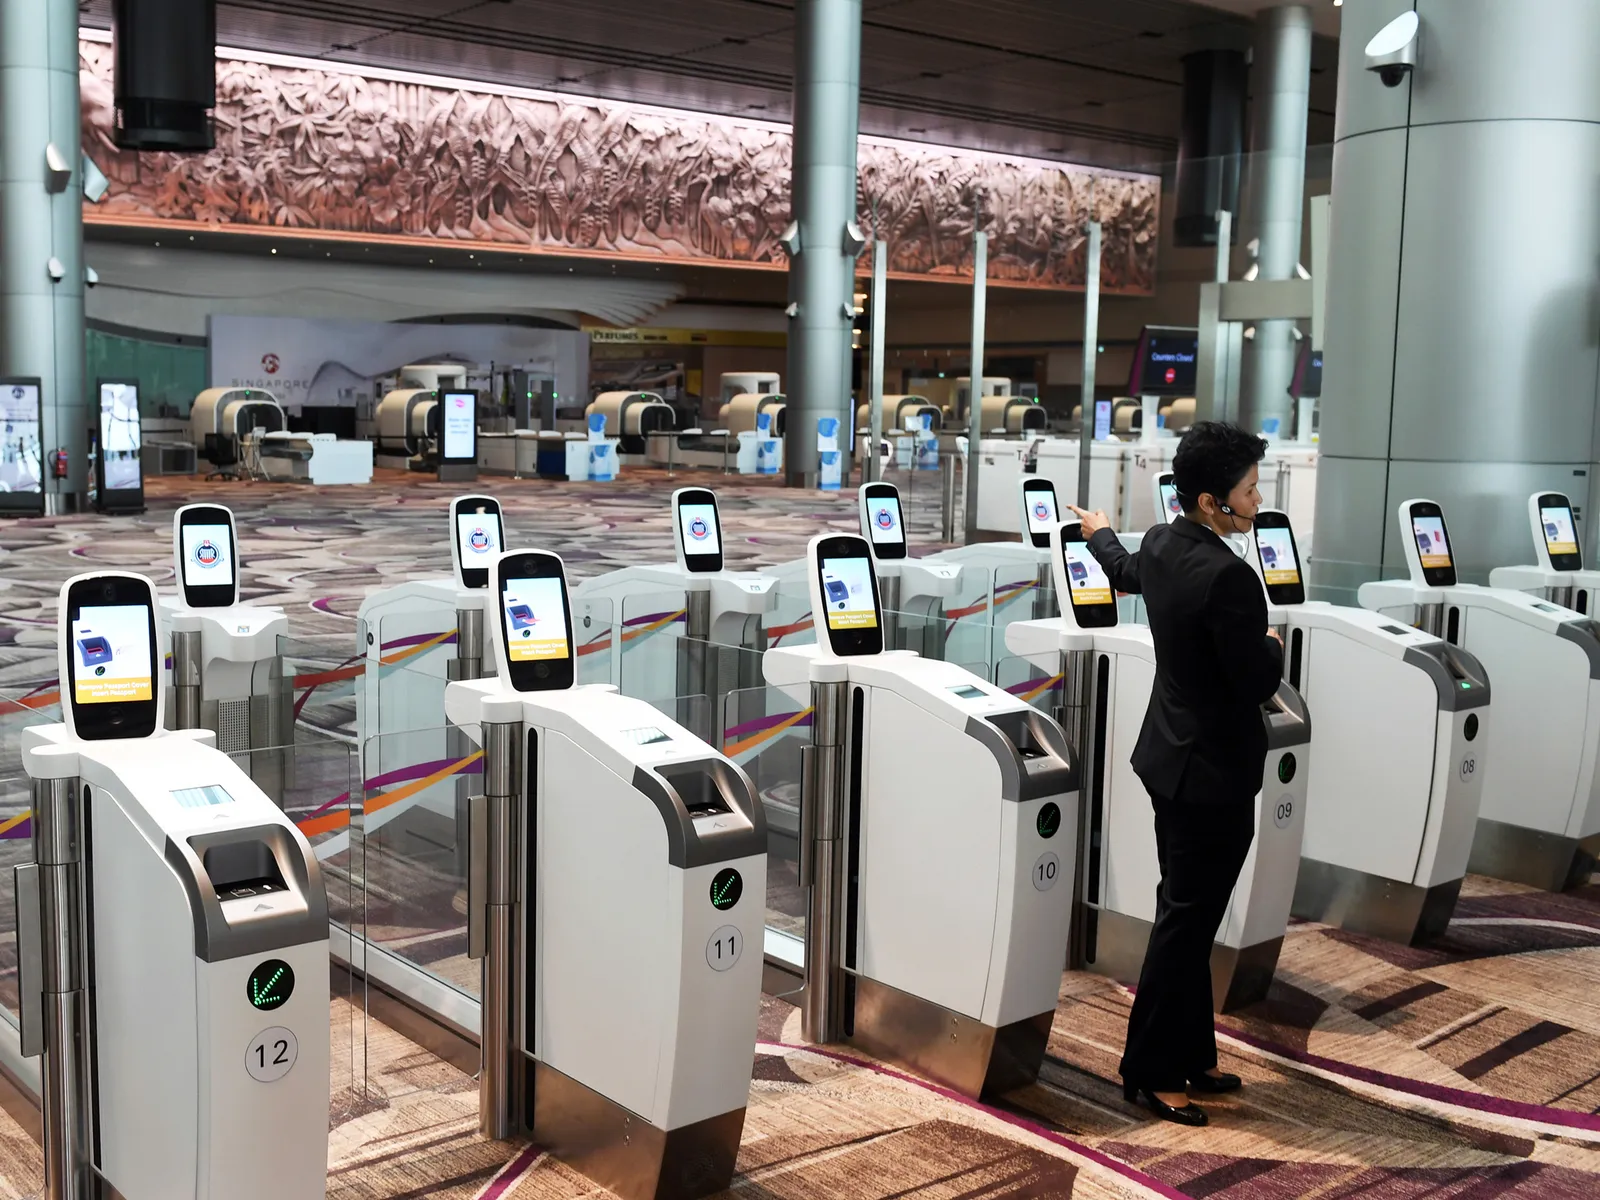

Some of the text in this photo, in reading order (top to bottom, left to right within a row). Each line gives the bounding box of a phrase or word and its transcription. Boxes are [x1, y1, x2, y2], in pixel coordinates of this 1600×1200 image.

[1134, 454, 1147, 469] T4
[1463, 759, 1475, 774] 08
[1277, 802, 1292, 820] 09
[1038, 861, 1056, 881] 10
[714, 935, 735, 959] 11
[255, 1039, 289, 1068] 12
